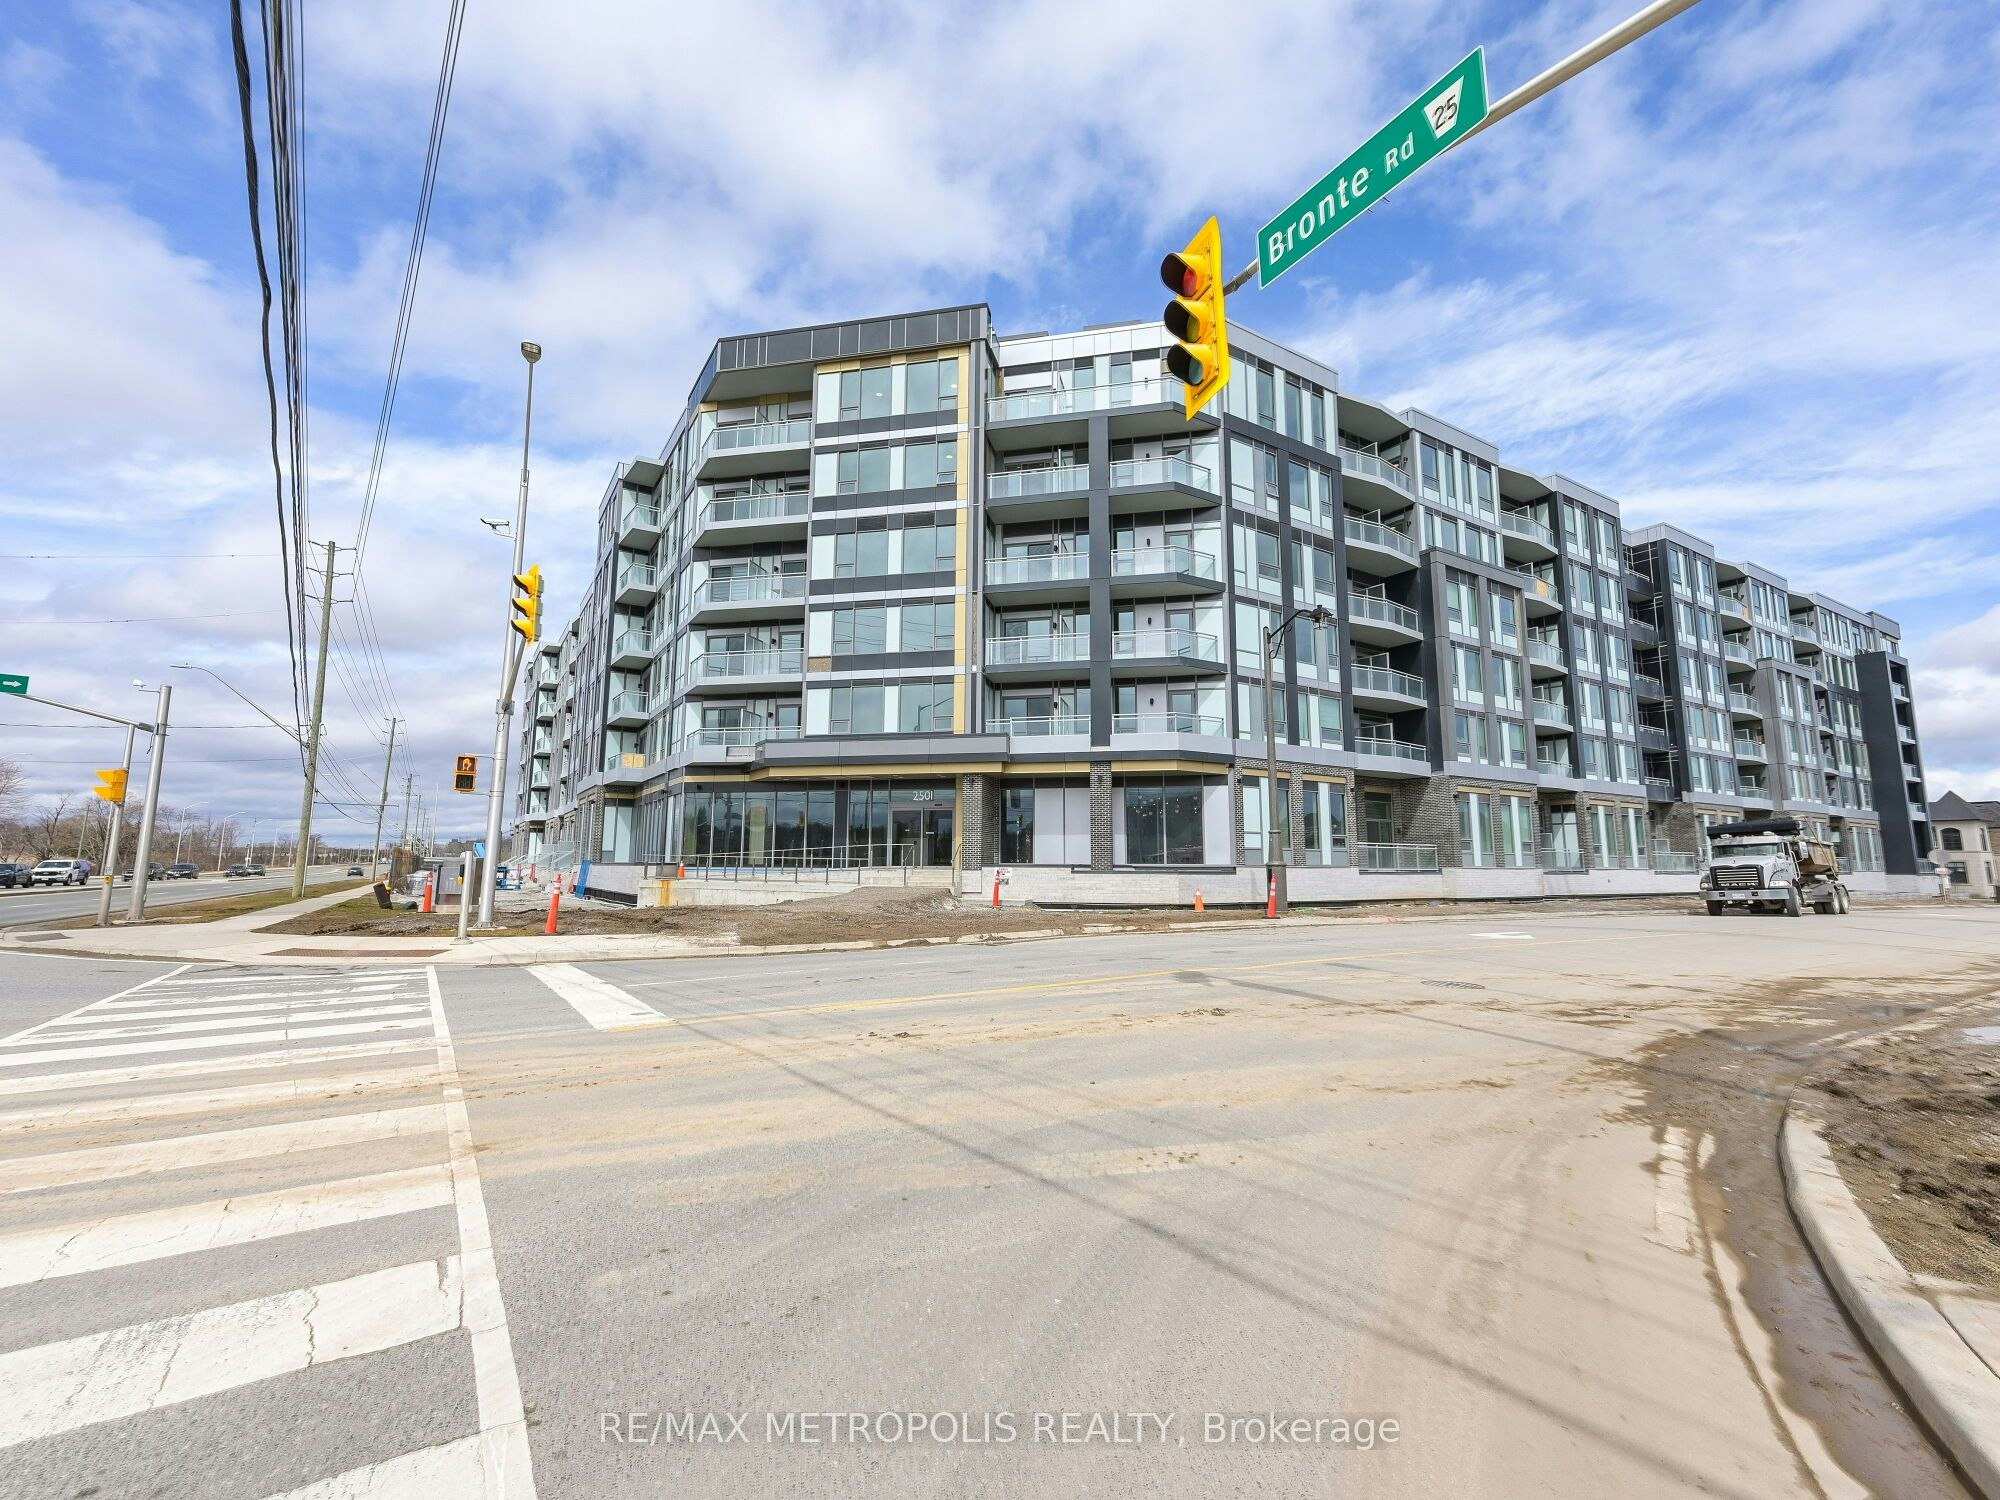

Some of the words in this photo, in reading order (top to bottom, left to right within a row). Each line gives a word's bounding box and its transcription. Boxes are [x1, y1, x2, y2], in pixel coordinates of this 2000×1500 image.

[1432, 94, 1458, 131] 25
[1268, 166, 1370, 266] Bronte
[1384, 131, 1415, 175] Rd
[912, 790, 933, 801] 2501
